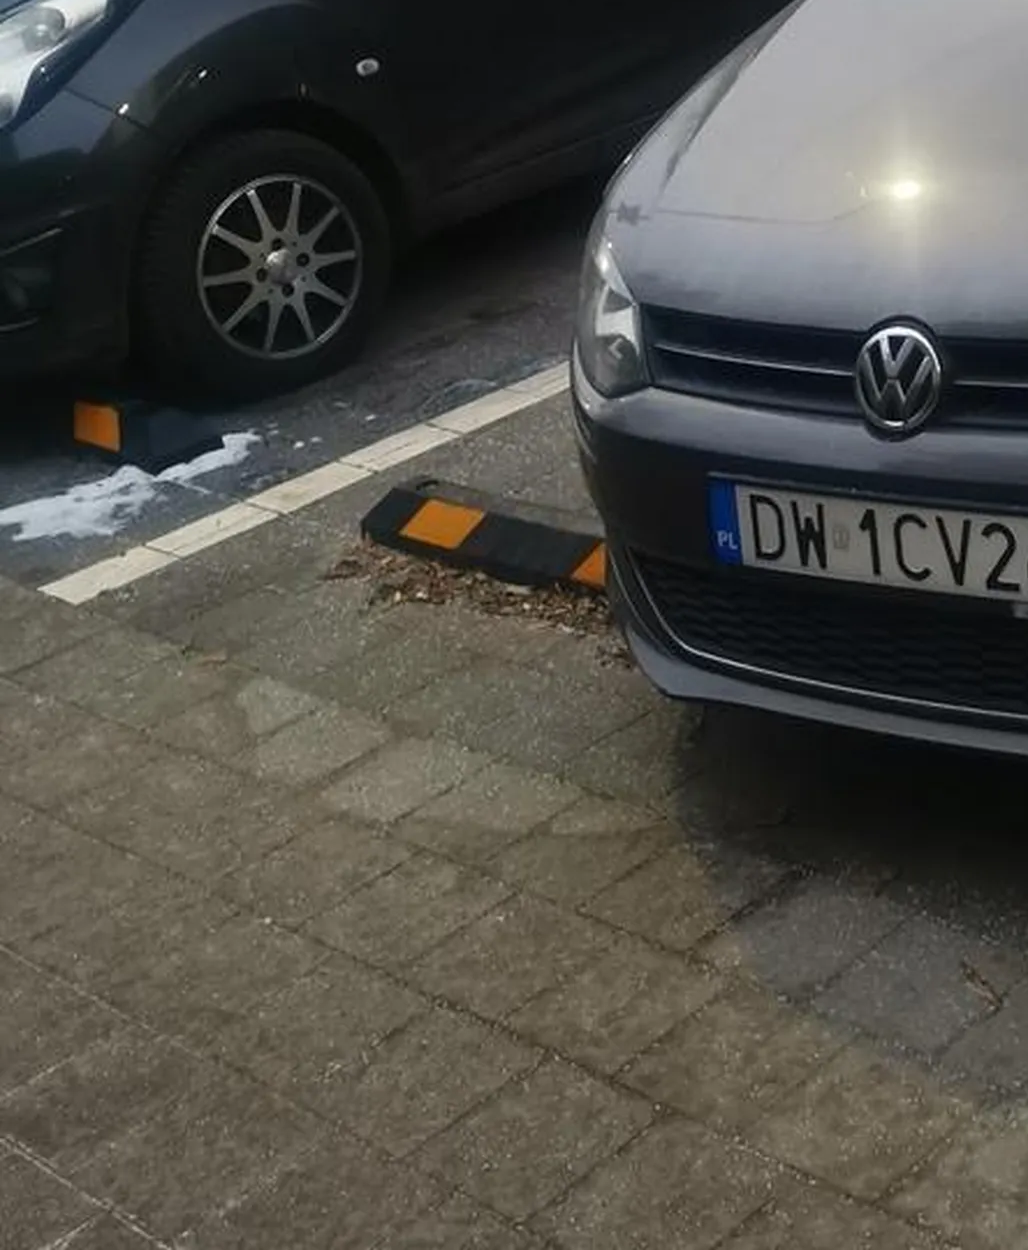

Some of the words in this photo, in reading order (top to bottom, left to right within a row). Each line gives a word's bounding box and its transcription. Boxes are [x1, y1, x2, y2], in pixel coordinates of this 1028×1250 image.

[860, 330, 937, 425] VW
[716, 530, 739, 550] PL
[749, 493, 828, 570] DW
